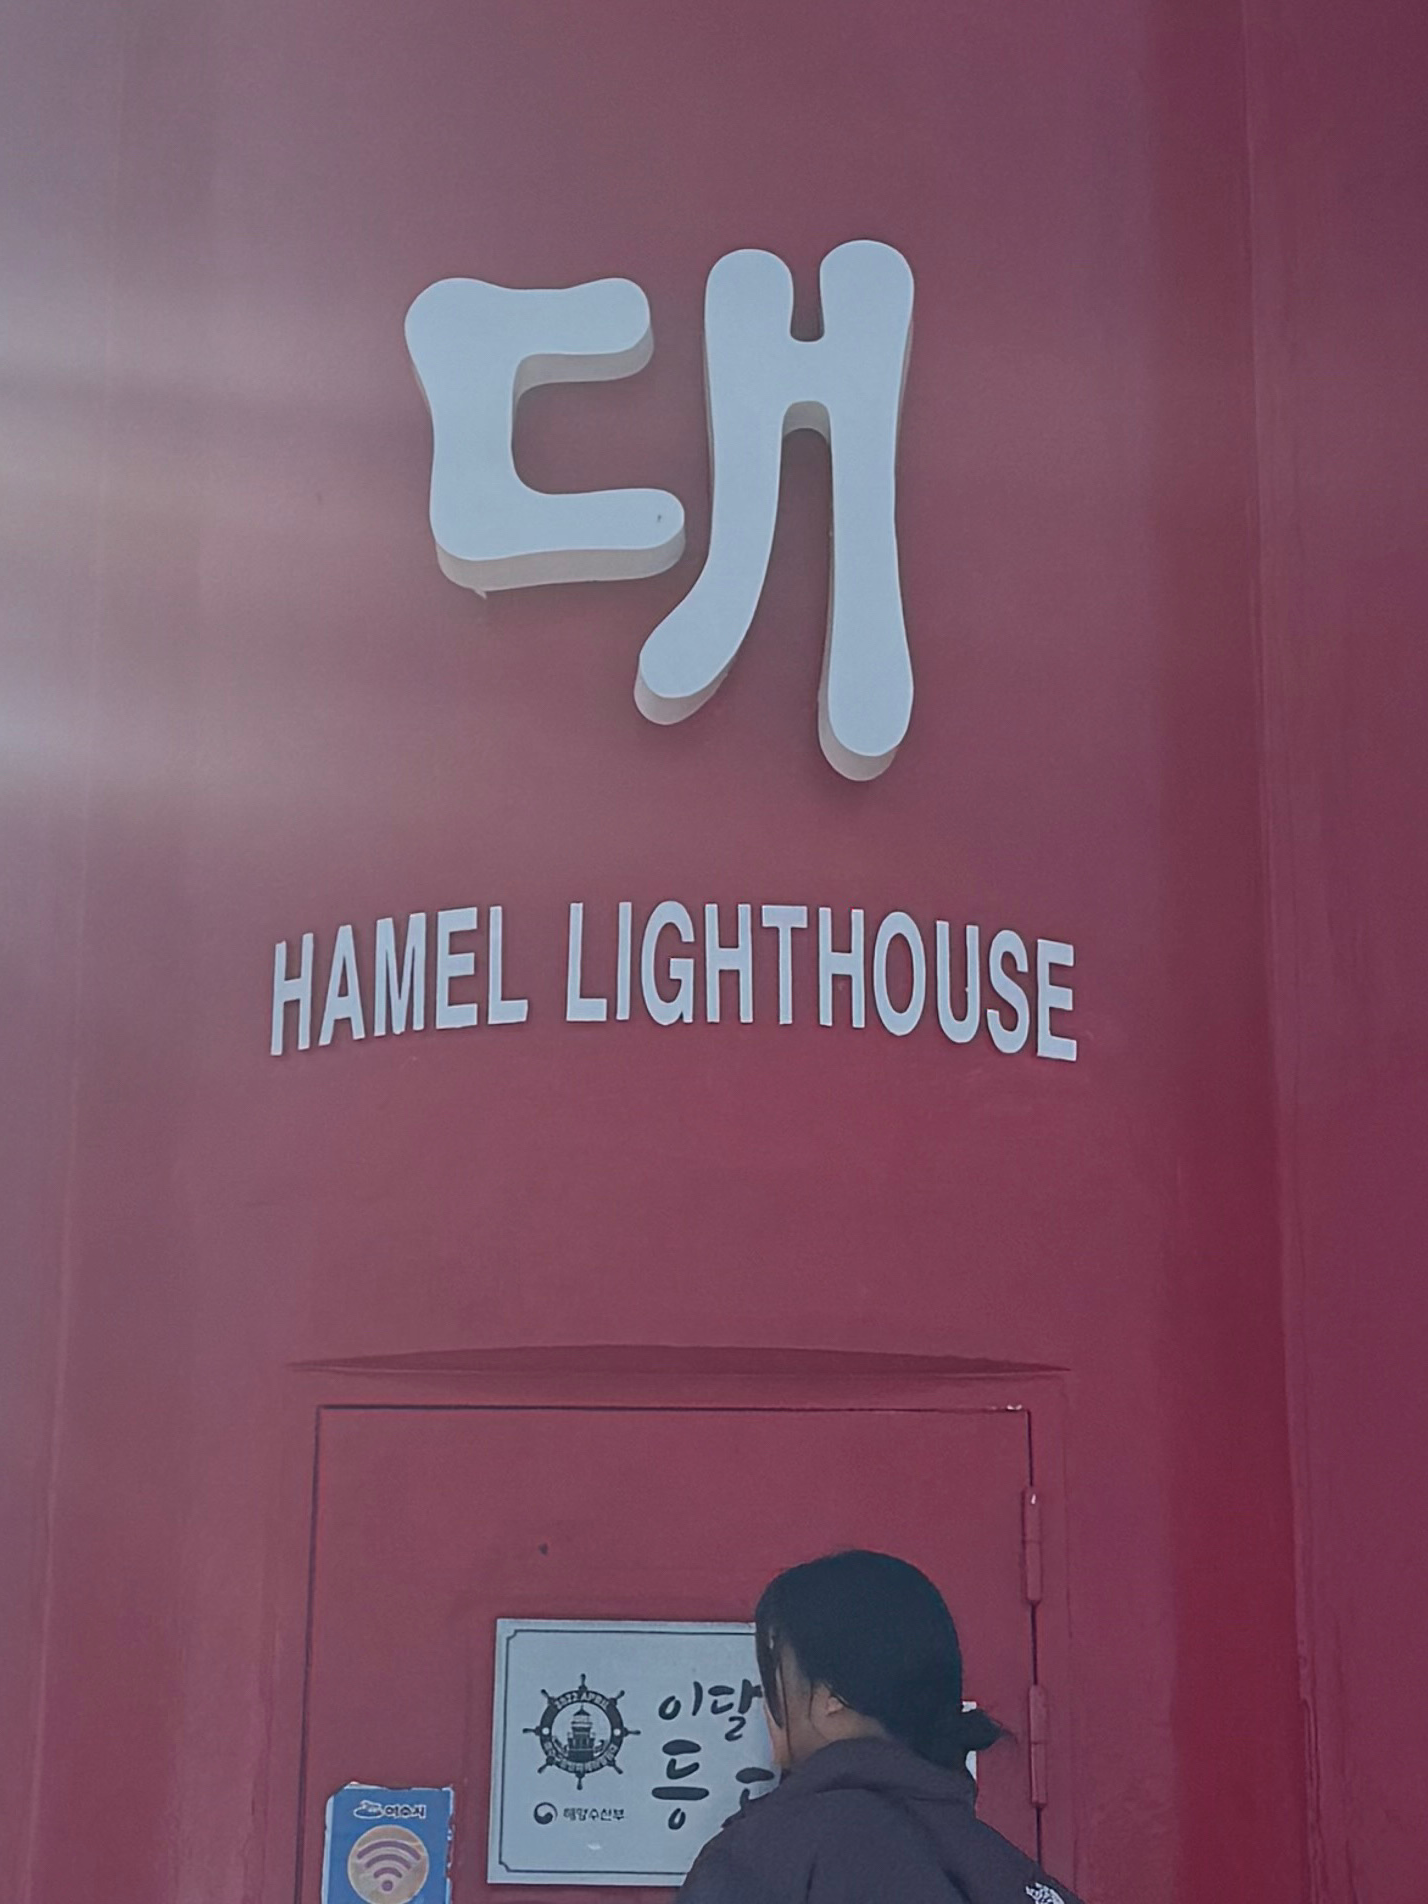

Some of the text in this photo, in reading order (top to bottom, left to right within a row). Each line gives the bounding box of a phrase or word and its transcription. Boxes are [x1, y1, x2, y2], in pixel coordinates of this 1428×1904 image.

[269, 900, 1078, 1062] HAMEL LIGHTHOUSE
[385, 1804, 426, 1819] 여수시
[563, 1807, 625, 1822] 해양수산부
